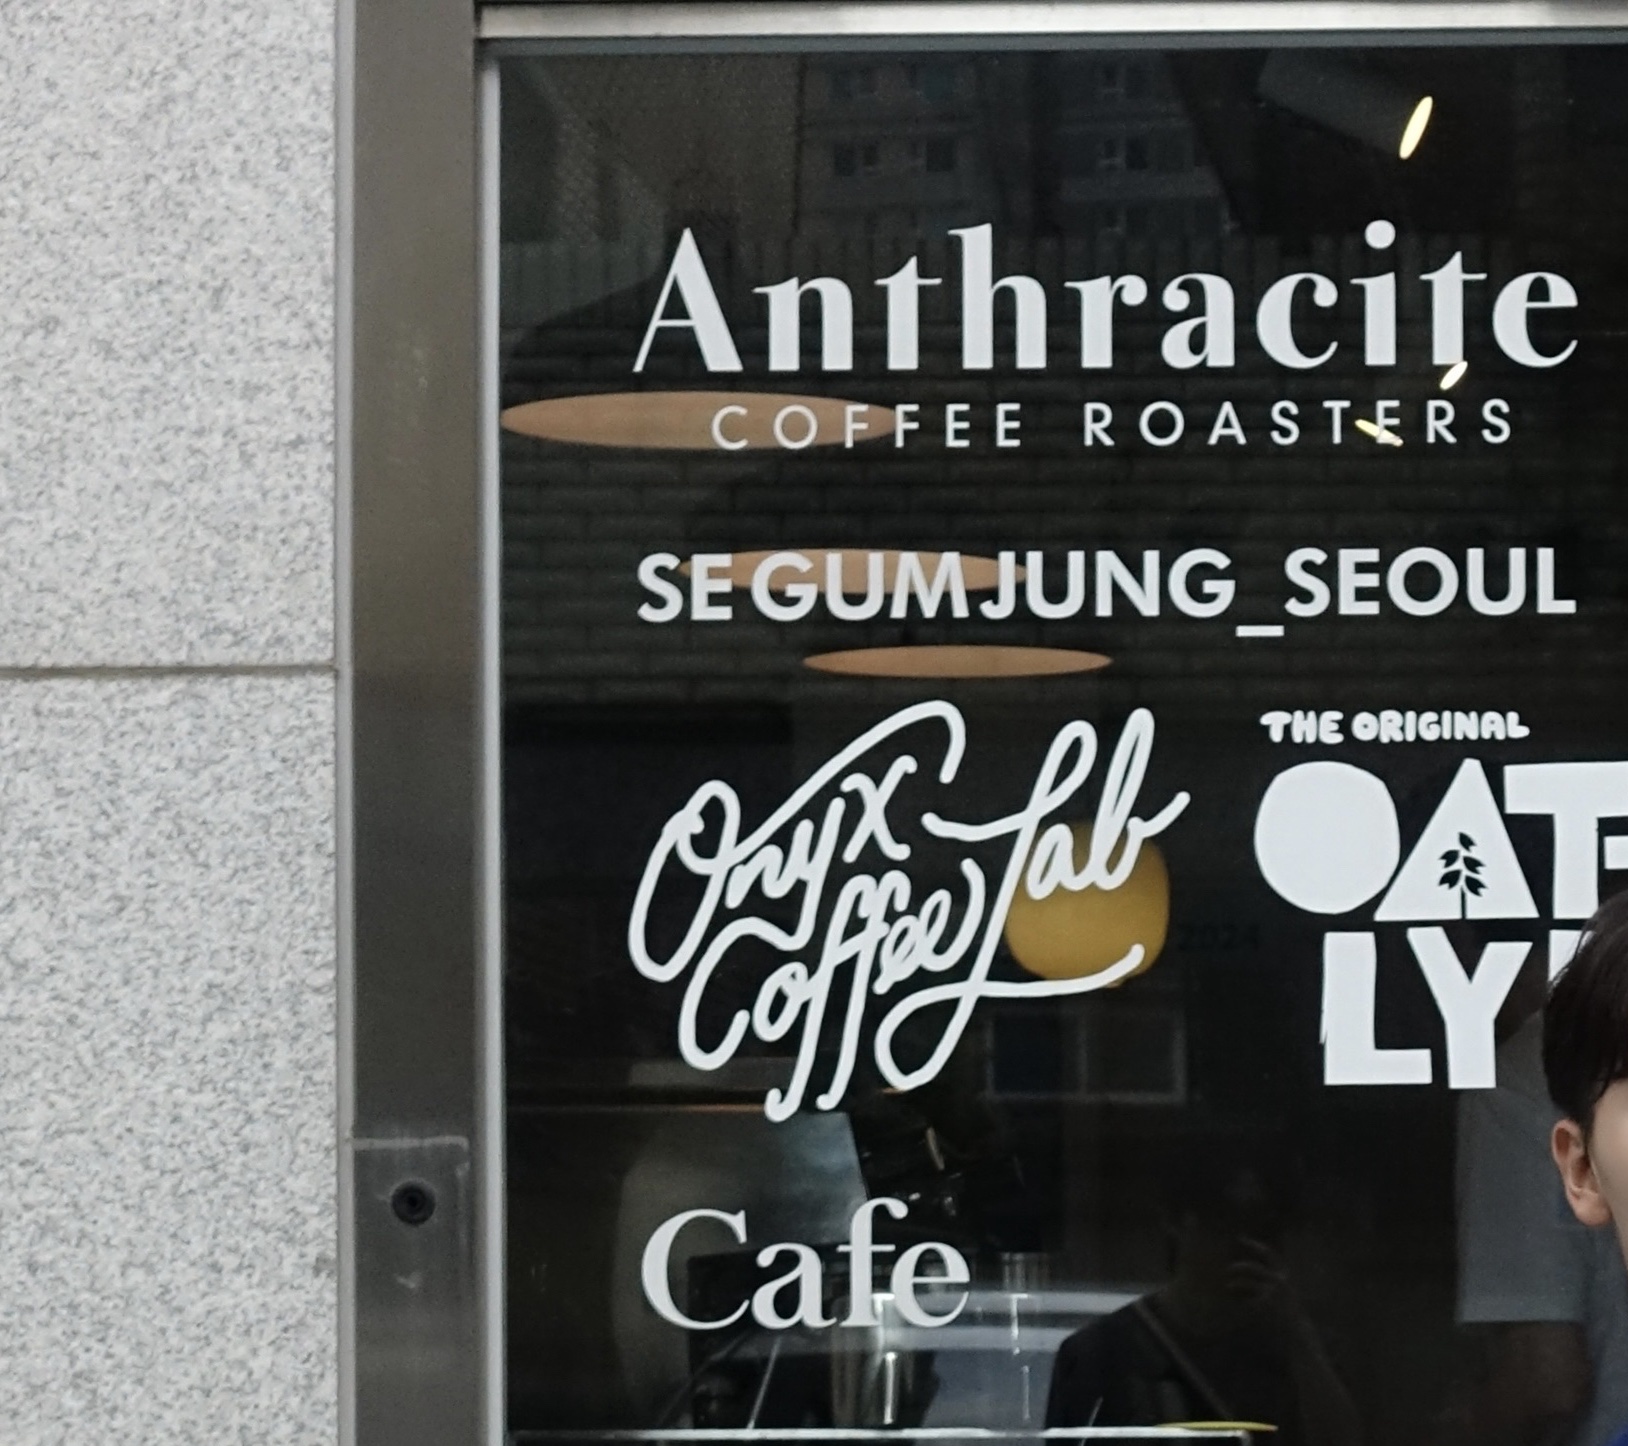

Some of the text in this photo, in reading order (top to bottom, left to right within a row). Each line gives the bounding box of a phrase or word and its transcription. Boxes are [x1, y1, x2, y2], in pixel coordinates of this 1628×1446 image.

[633, 220, 1578, 374] Anthracite
[711, 399, 1511, 450] COFFEE ROASTERS
[1259, 709, 1531, 745] THE ORIGINAL
[628, 700, 967, 984] Onyx
[875, 707, 1191, 1093] Lab
[678, 856, 987, 1122] Coffee
[641, 1197, 970, 1331] Cafe
